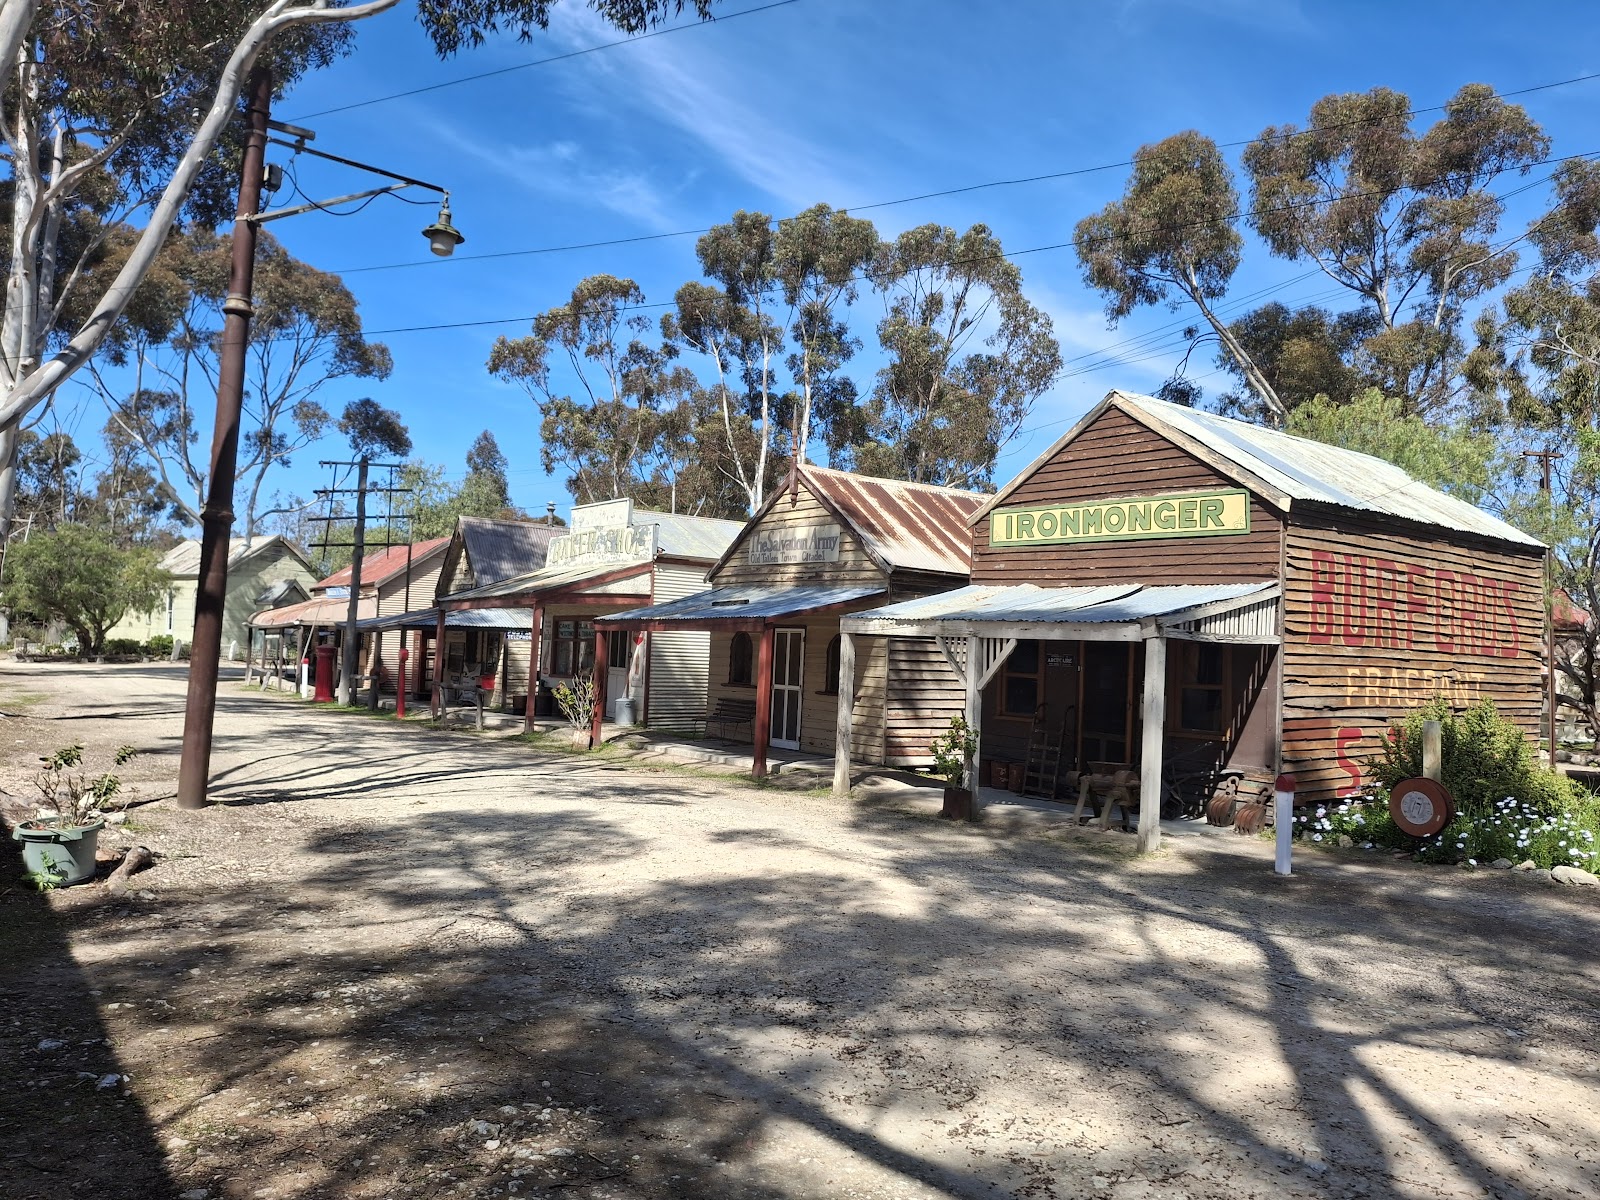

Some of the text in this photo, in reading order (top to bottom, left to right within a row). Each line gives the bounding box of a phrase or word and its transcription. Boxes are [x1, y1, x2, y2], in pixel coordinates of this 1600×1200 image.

[1005, 498, 1225, 540] IRONMONGER
[751, 527, 839, 553] The Salvation Army
[751, 553, 760, 564] Old
[802, 550, 825, 561] Citadel
[1308, 550, 1521, 658] BURFORDS
[1346, 668, 1485, 706] FRAGRANT
